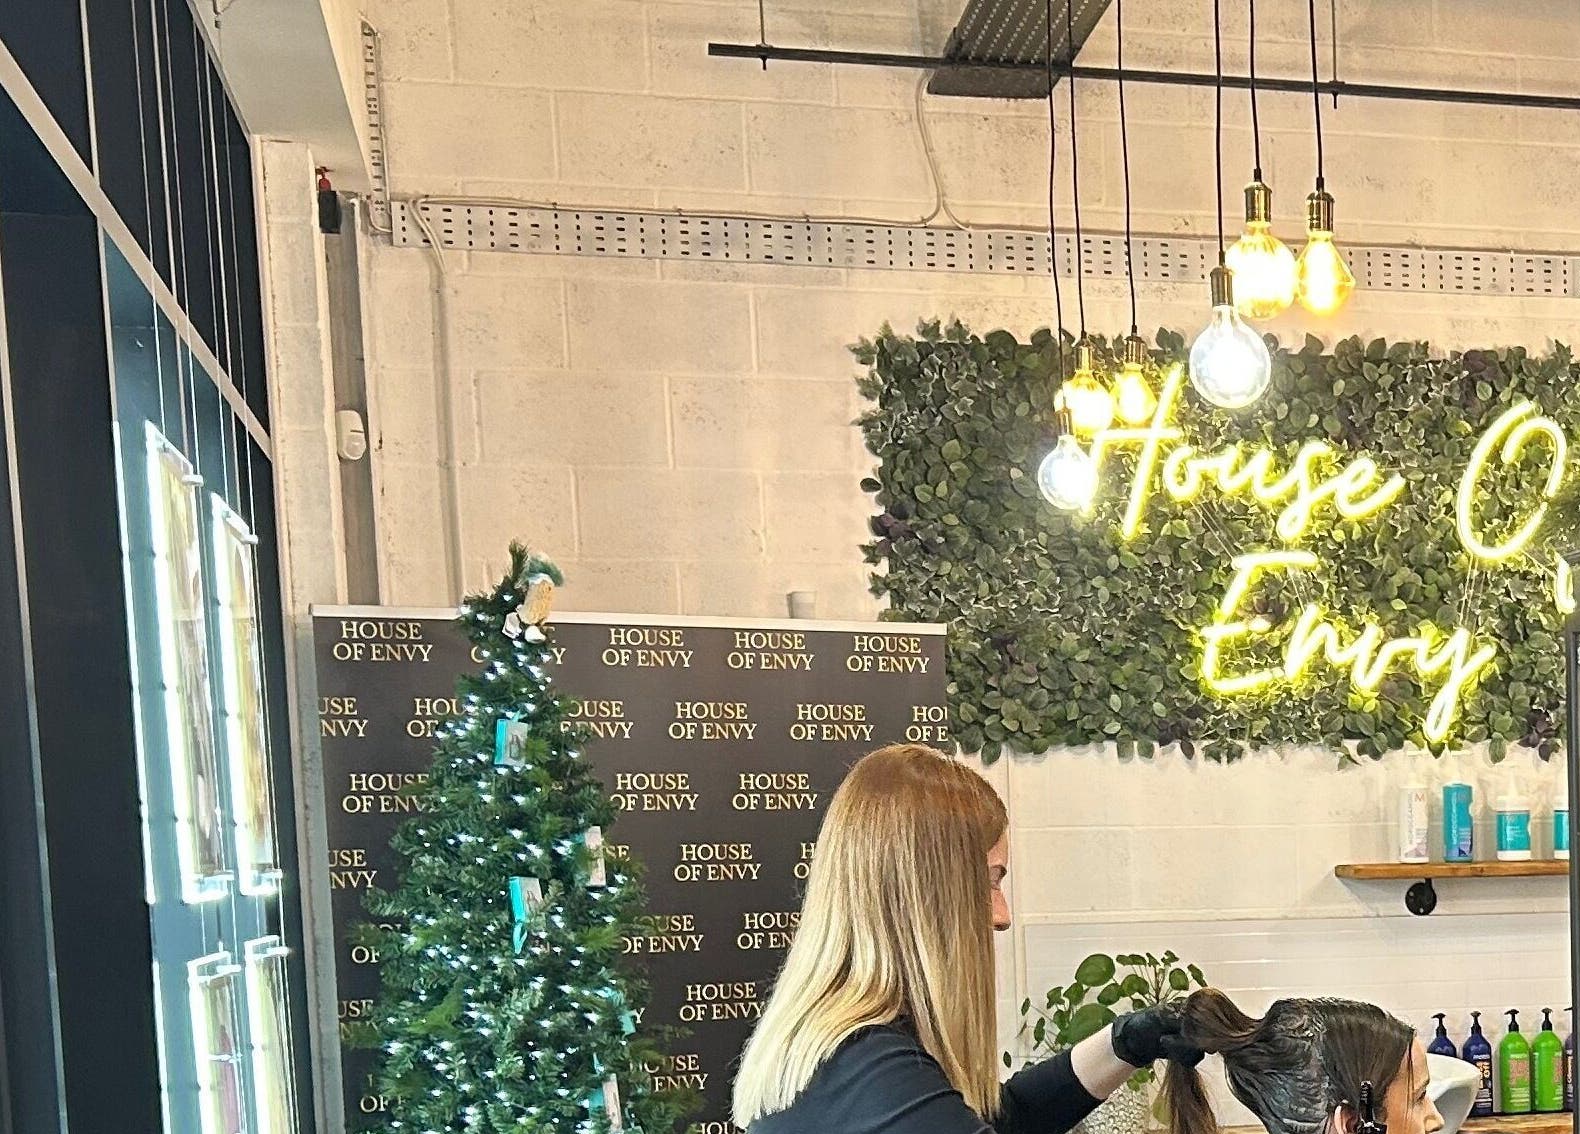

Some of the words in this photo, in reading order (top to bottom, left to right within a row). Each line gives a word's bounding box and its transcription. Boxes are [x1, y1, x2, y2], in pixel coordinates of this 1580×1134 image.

[1080, 362, 1406, 542] House
[340, 620, 423, 640] HOUSE
[609, 628, 684, 647] HOUSE
[734, 631, 806, 650] HOUSE
[853, 635, 922, 653] HOUSE
[1197, 548, 1498, 743] Envy
[333, 642, 366, 661] OF
[371, 643, 433, 662] ENVY
[602, 648, 630, 667] OF
[637, 649, 693, 668] ENVY
[727, 652, 755, 669] OF
[760, 653, 815, 671] ENVY
[846, 655, 873, 672] OF
[877, 657, 930, 674] ENVY
[675, 702, 748, 720] HOUSE
[797, 703, 866, 721] HOUSE
[668, 722, 697, 740] OF
[702, 723, 757, 741] ENVY
[790, 724, 818, 741] OF
[822, 724, 875, 742] ENVY
[905, 725, 933, 742] OF
[616, 773, 690, 791] HOUSE
[739, 773, 810, 791] HOUSE
[342, 795, 375, 813] OF
[642, 794, 699, 811] ENVY
[732, 794, 761, 810] OF
[764, 794, 818, 811] ENVY
[680, 843, 753, 861] HOUSE
[674, 864, 702, 881] OF
[707, 863, 762, 881] ENVY
[648, 934, 704, 953] ENVY
[737, 932, 766, 950] OF
[686, 982, 757, 1000] HOUSE
[679, 1004, 706, 1021] OF
[712, 1001, 765, 1020] ENVY
